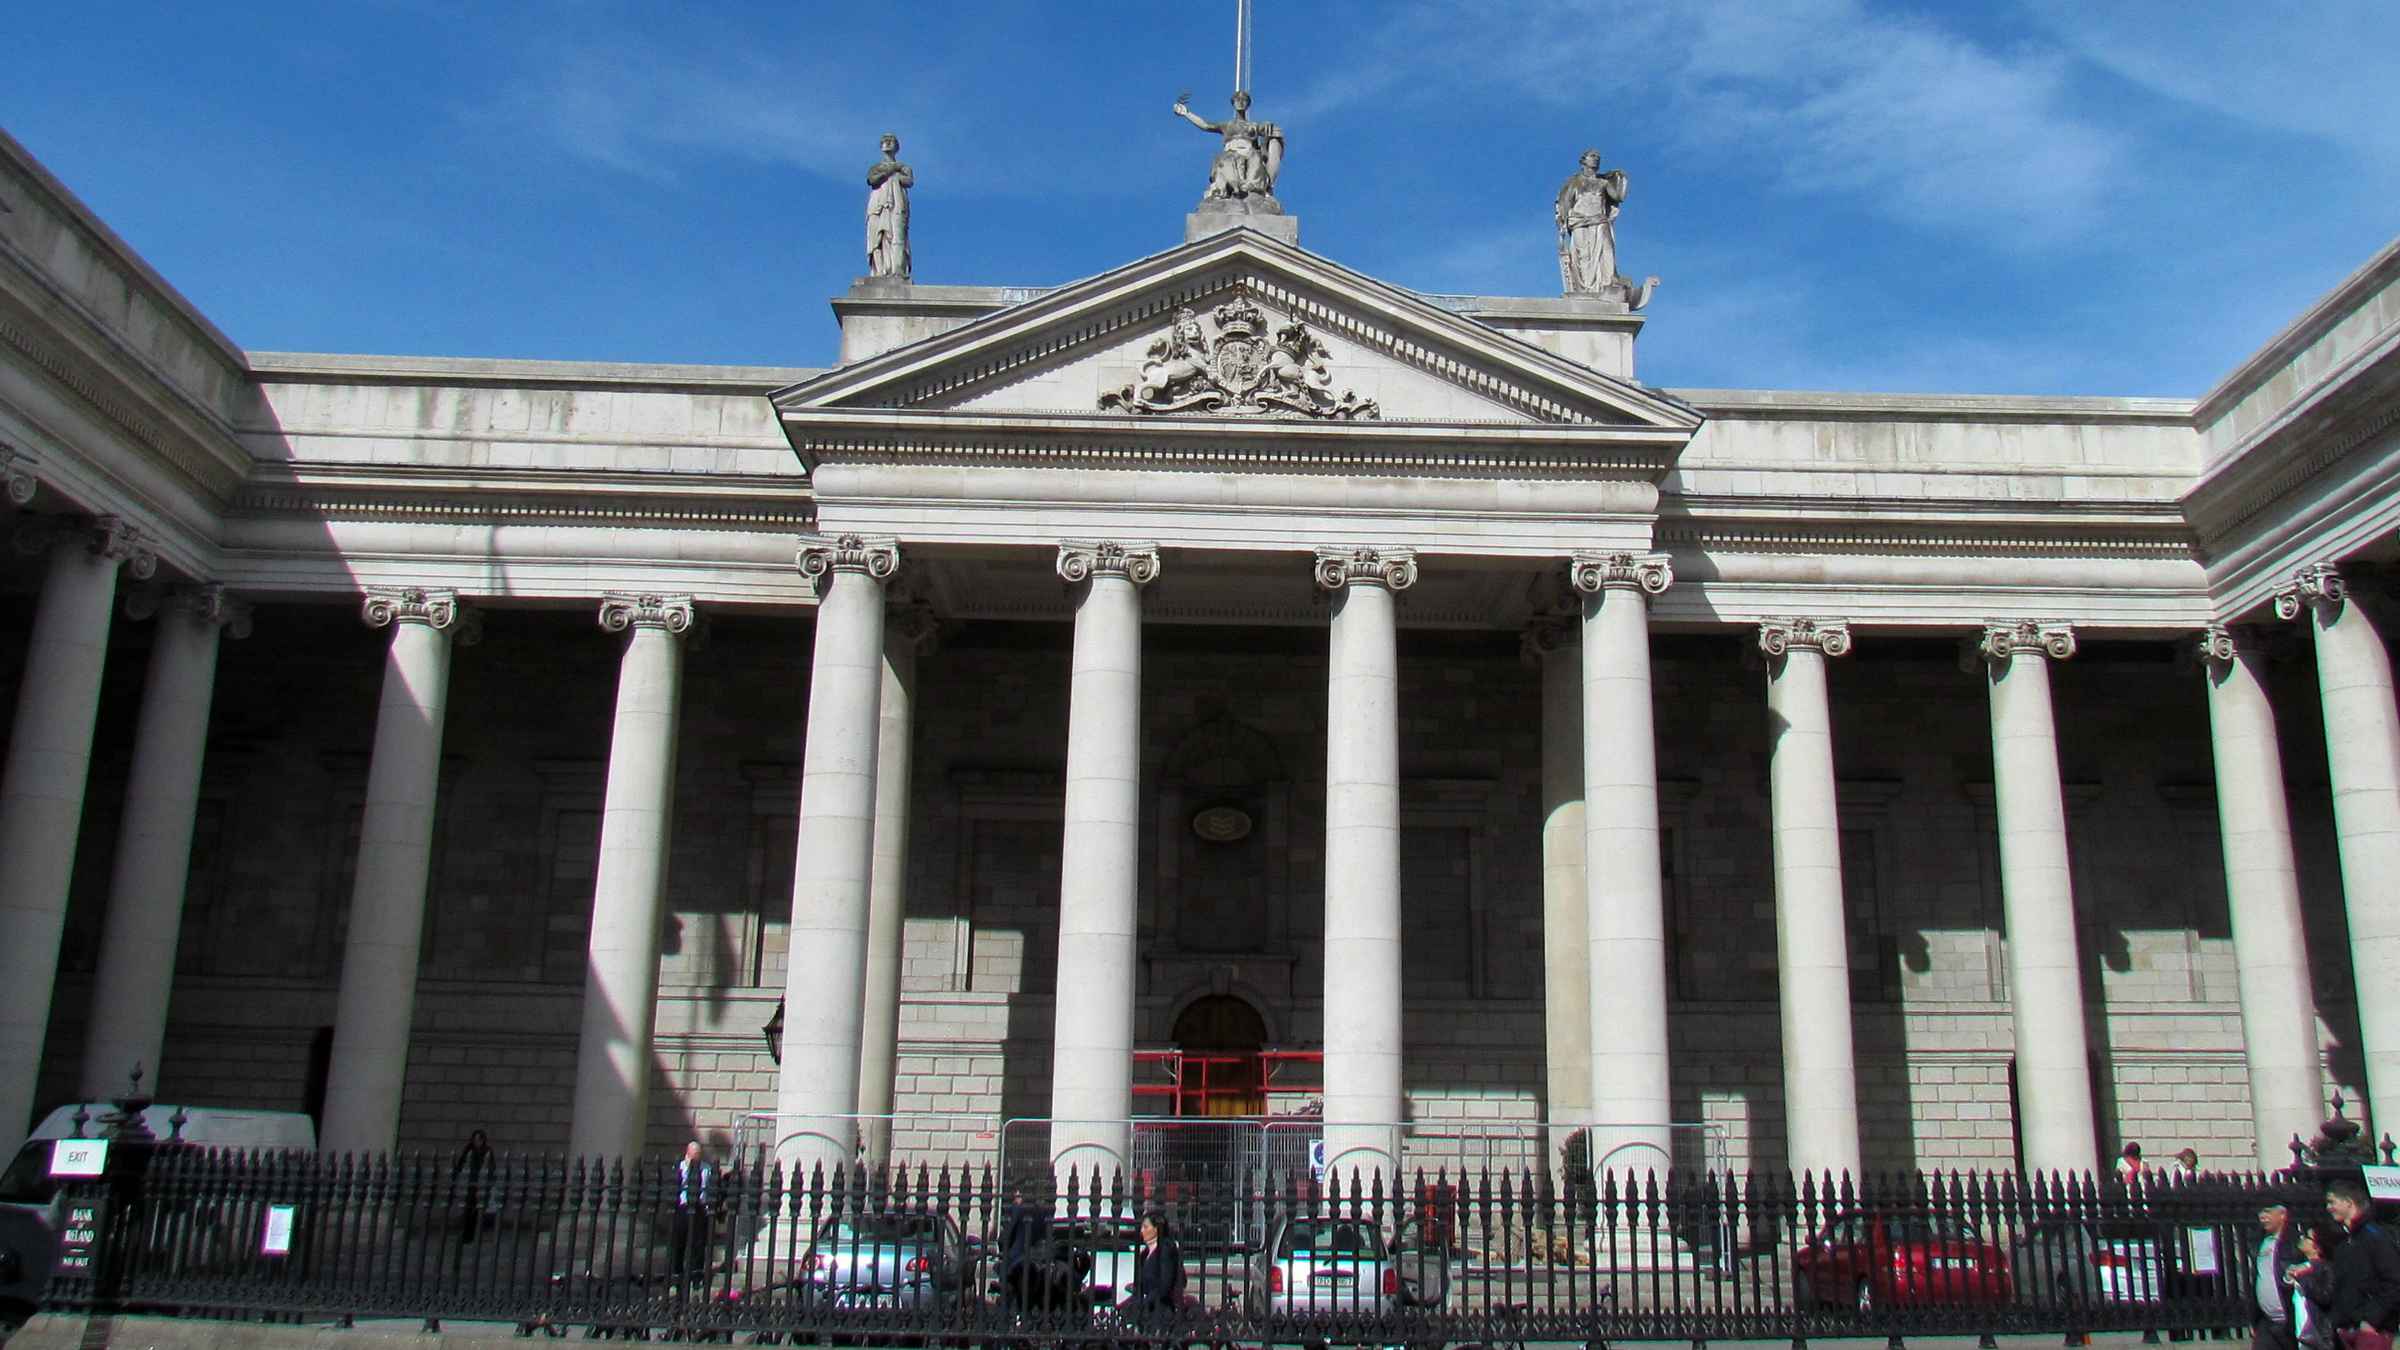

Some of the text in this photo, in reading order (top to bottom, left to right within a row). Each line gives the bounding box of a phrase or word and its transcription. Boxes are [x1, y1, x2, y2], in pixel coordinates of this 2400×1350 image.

[68, 1151, 88, 1162] EXIT
[72, 1208, 93, 1221] BANK
[64, 1229, 94, 1242] IRELAND
